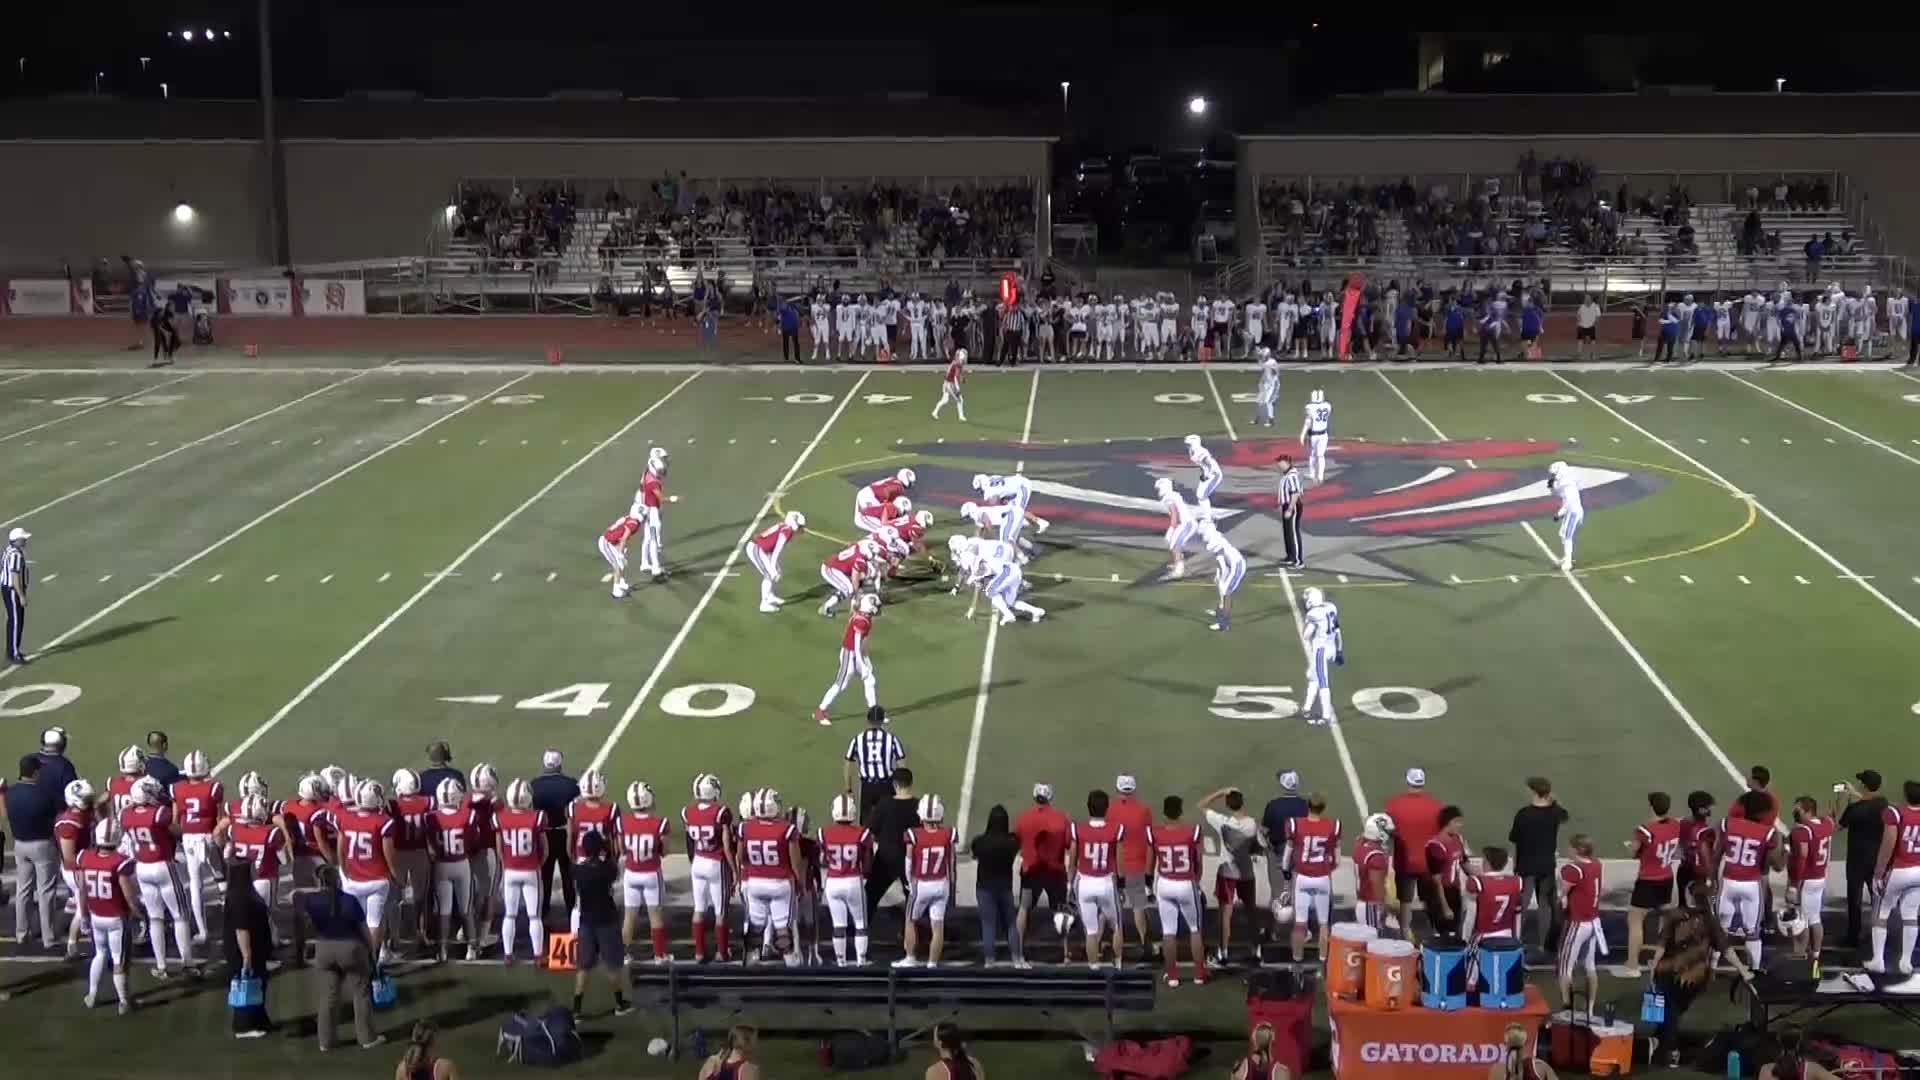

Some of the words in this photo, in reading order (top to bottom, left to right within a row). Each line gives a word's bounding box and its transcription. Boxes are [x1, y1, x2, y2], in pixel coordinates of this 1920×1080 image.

[867, 740, 884, 762] H
[185, 798, 200, 823] 2
[344, 830, 373, 859] 75
[502, 828, 532, 856] 48
[624, 834, 654, 862] 40
[747, 840, 780, 865] 66
[1084, 842, 1109, 870] 41
[1302, 835, 1329, 863] 15
[1725, 836, 1761, 866] 36
[827, 844, 858, 870] 39
[921, 846, 945, 874] 17
[1158, 845, 1190, 872] 33
[84, 870, 112, 899] 56
[1493, 895, 1511, 923] 7
[1387, 965, 1401, 981] G
